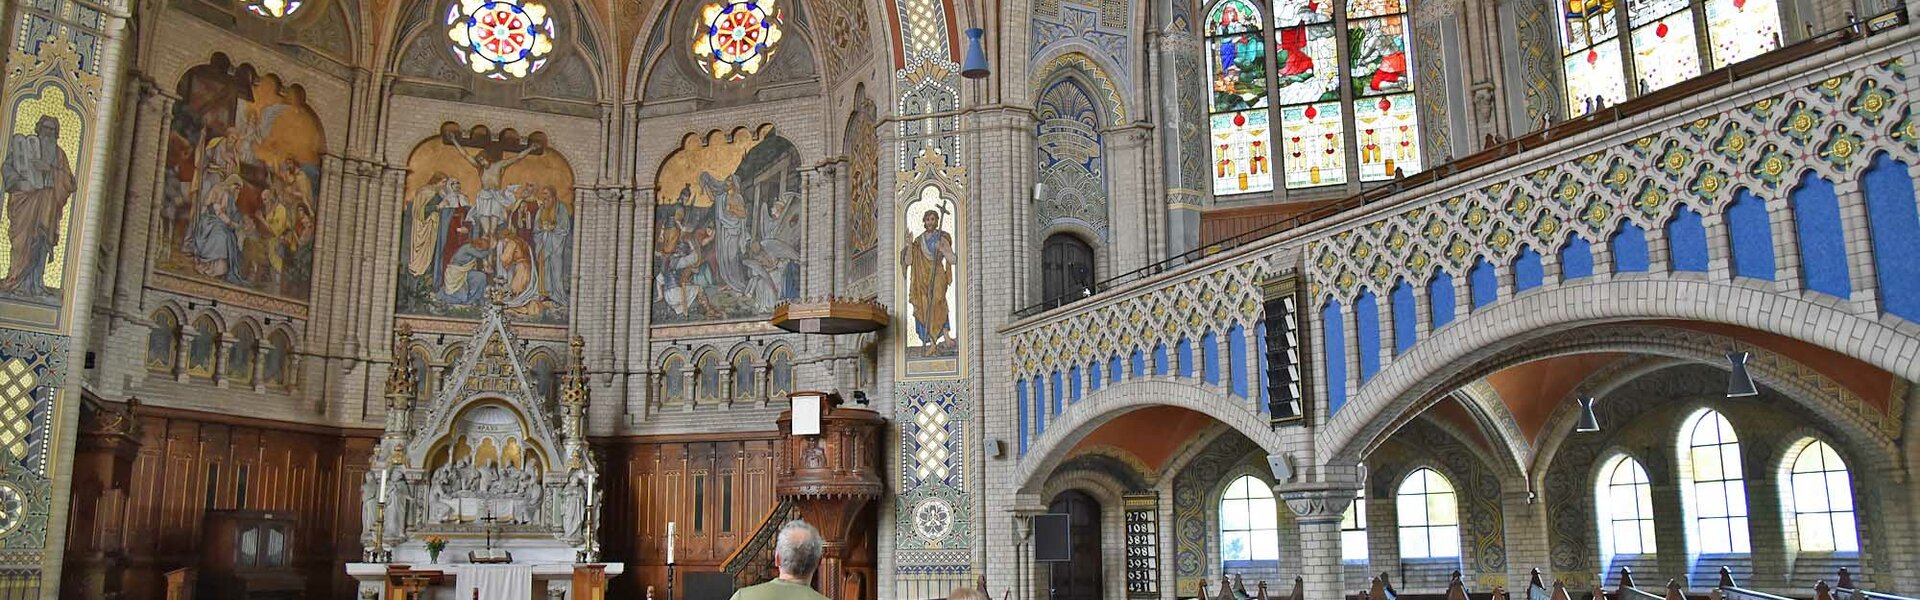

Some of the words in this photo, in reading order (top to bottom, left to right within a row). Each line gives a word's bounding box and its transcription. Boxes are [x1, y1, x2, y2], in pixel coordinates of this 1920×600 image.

[1127, 512, 1147, 521] 279
[1128, 523, 1147, 533] 108
[1128, 535, 1148, 545] 382
[1128, 547, 1148, 557] 398
[1128, 559, 1149, 568] 395
[1129, 582, 1148, 592] 421
